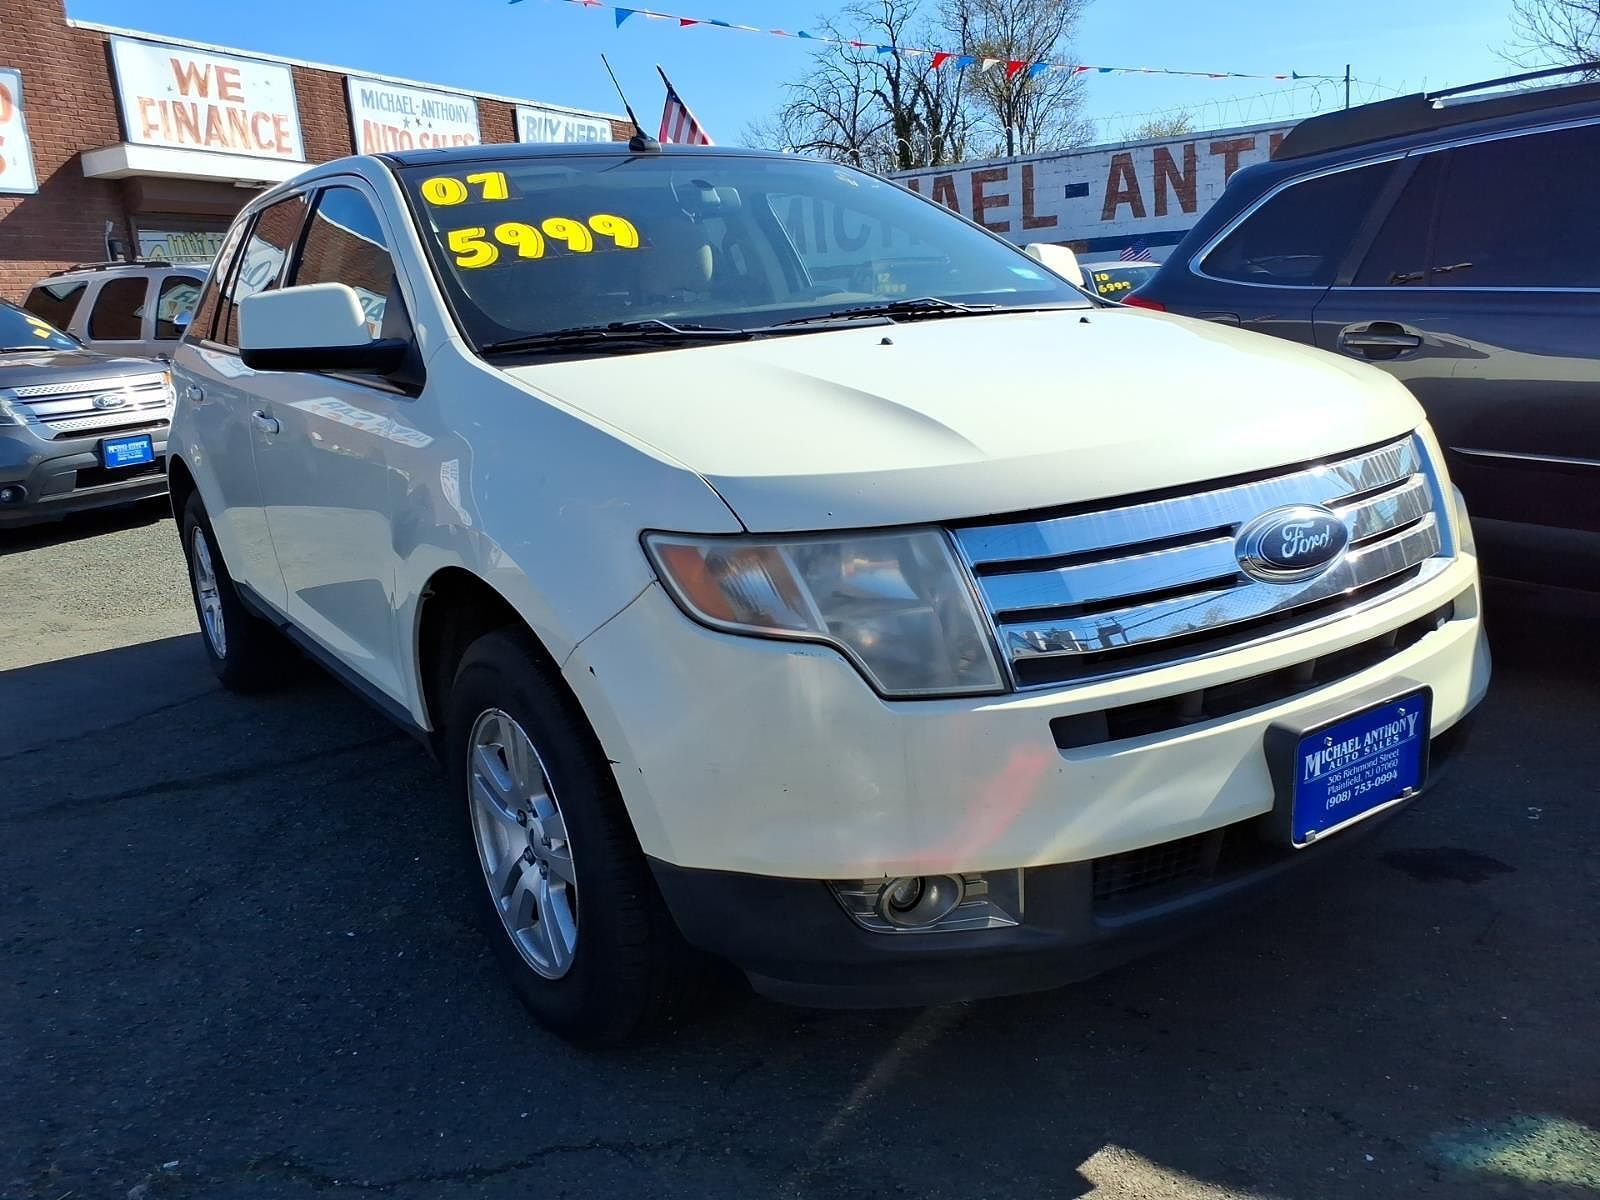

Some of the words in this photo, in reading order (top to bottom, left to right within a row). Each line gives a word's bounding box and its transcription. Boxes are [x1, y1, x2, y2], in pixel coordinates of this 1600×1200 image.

[170, 58, 245, 103] WE
[137, 96, 293, 153] FINANCE
[363, 119, 414, 155] AUTO
[421, 171, 509, 206] 07
[448, 214, 639, 269] 5999
[1281, 521, 1331, 558] Ford
[1304, 737, 1361, 781] MICHAEL
[1364, 711, 1419, 747] ANTHONY
[1328, 751, 1359, 771] AUTO
[1364, 734, 1399, 755] SALES
[1343, 758, 1378, 777] Richmond
[1379, 748, 1400, 763] Street
[1326, 790, 1351, 810] (908)
[1354, 769, 1398, 796] 753-0994
